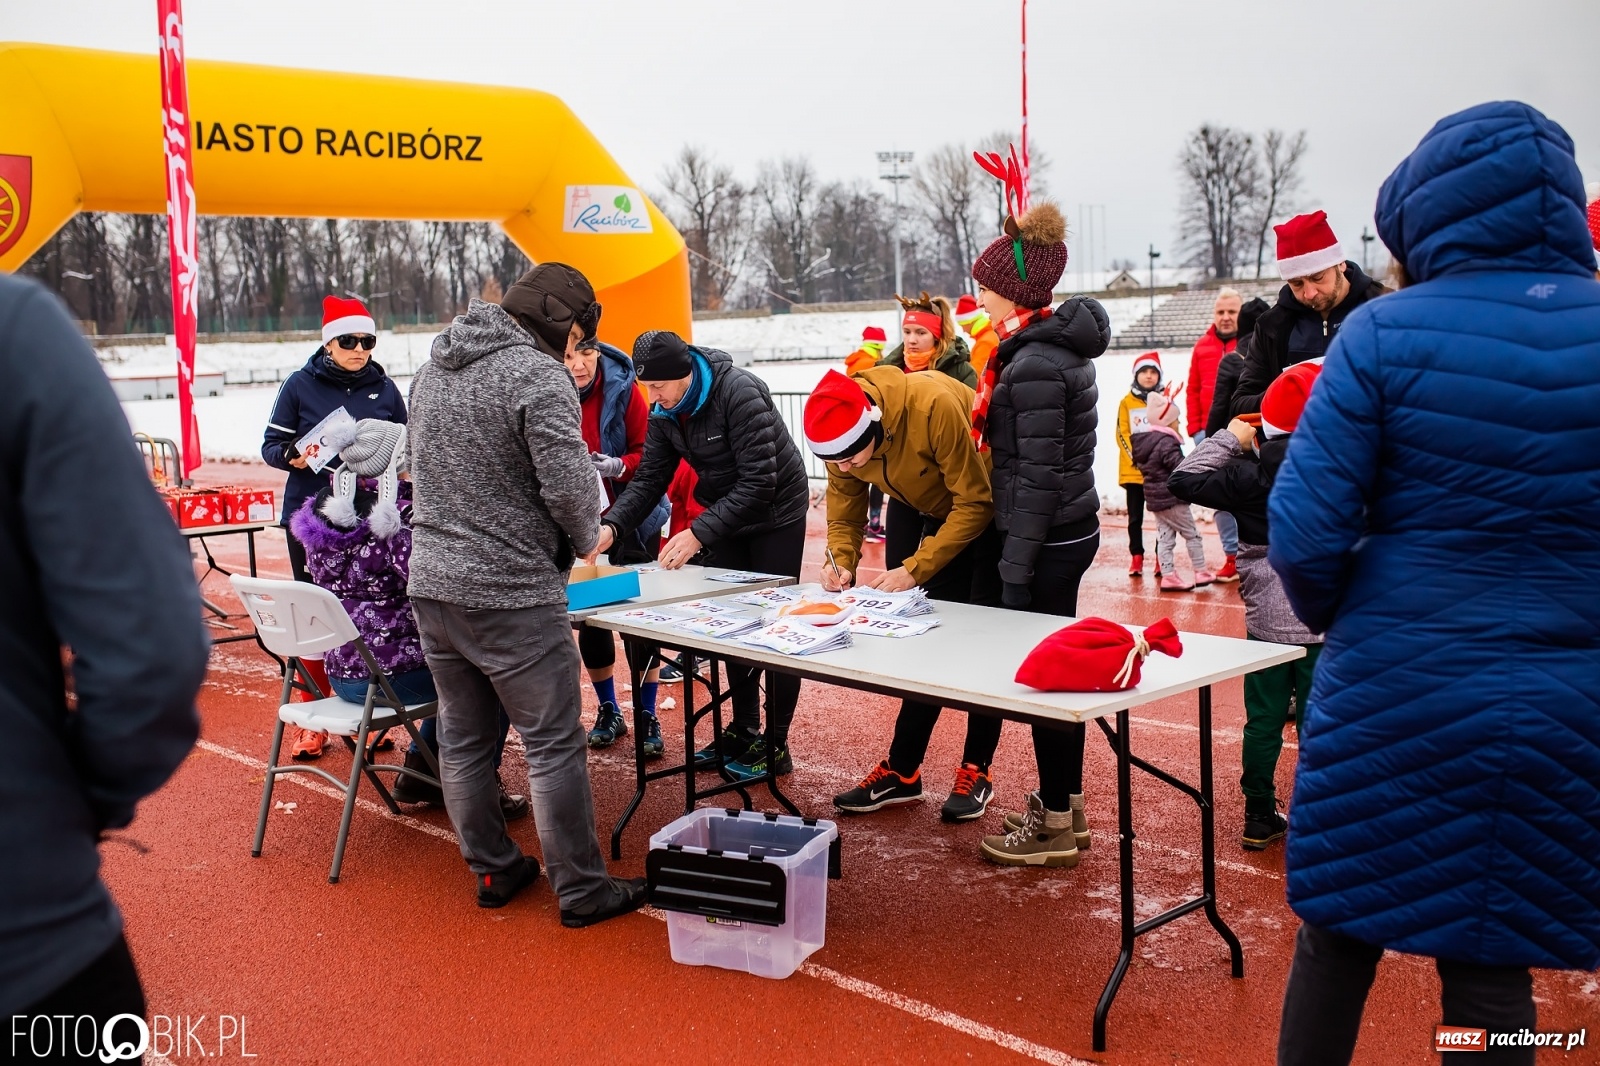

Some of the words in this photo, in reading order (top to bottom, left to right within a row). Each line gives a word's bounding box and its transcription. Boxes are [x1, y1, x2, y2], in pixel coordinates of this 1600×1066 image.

[195, 121, 304, 155] IASTO
[315, 127, 483, 162] RACIBÓRZ
[1526, 284, 1557, 299] 4F
[855, 599, 893, 611] 192
[869, 619, 910, 631] 157
[778, 630, 816, 646] 250
